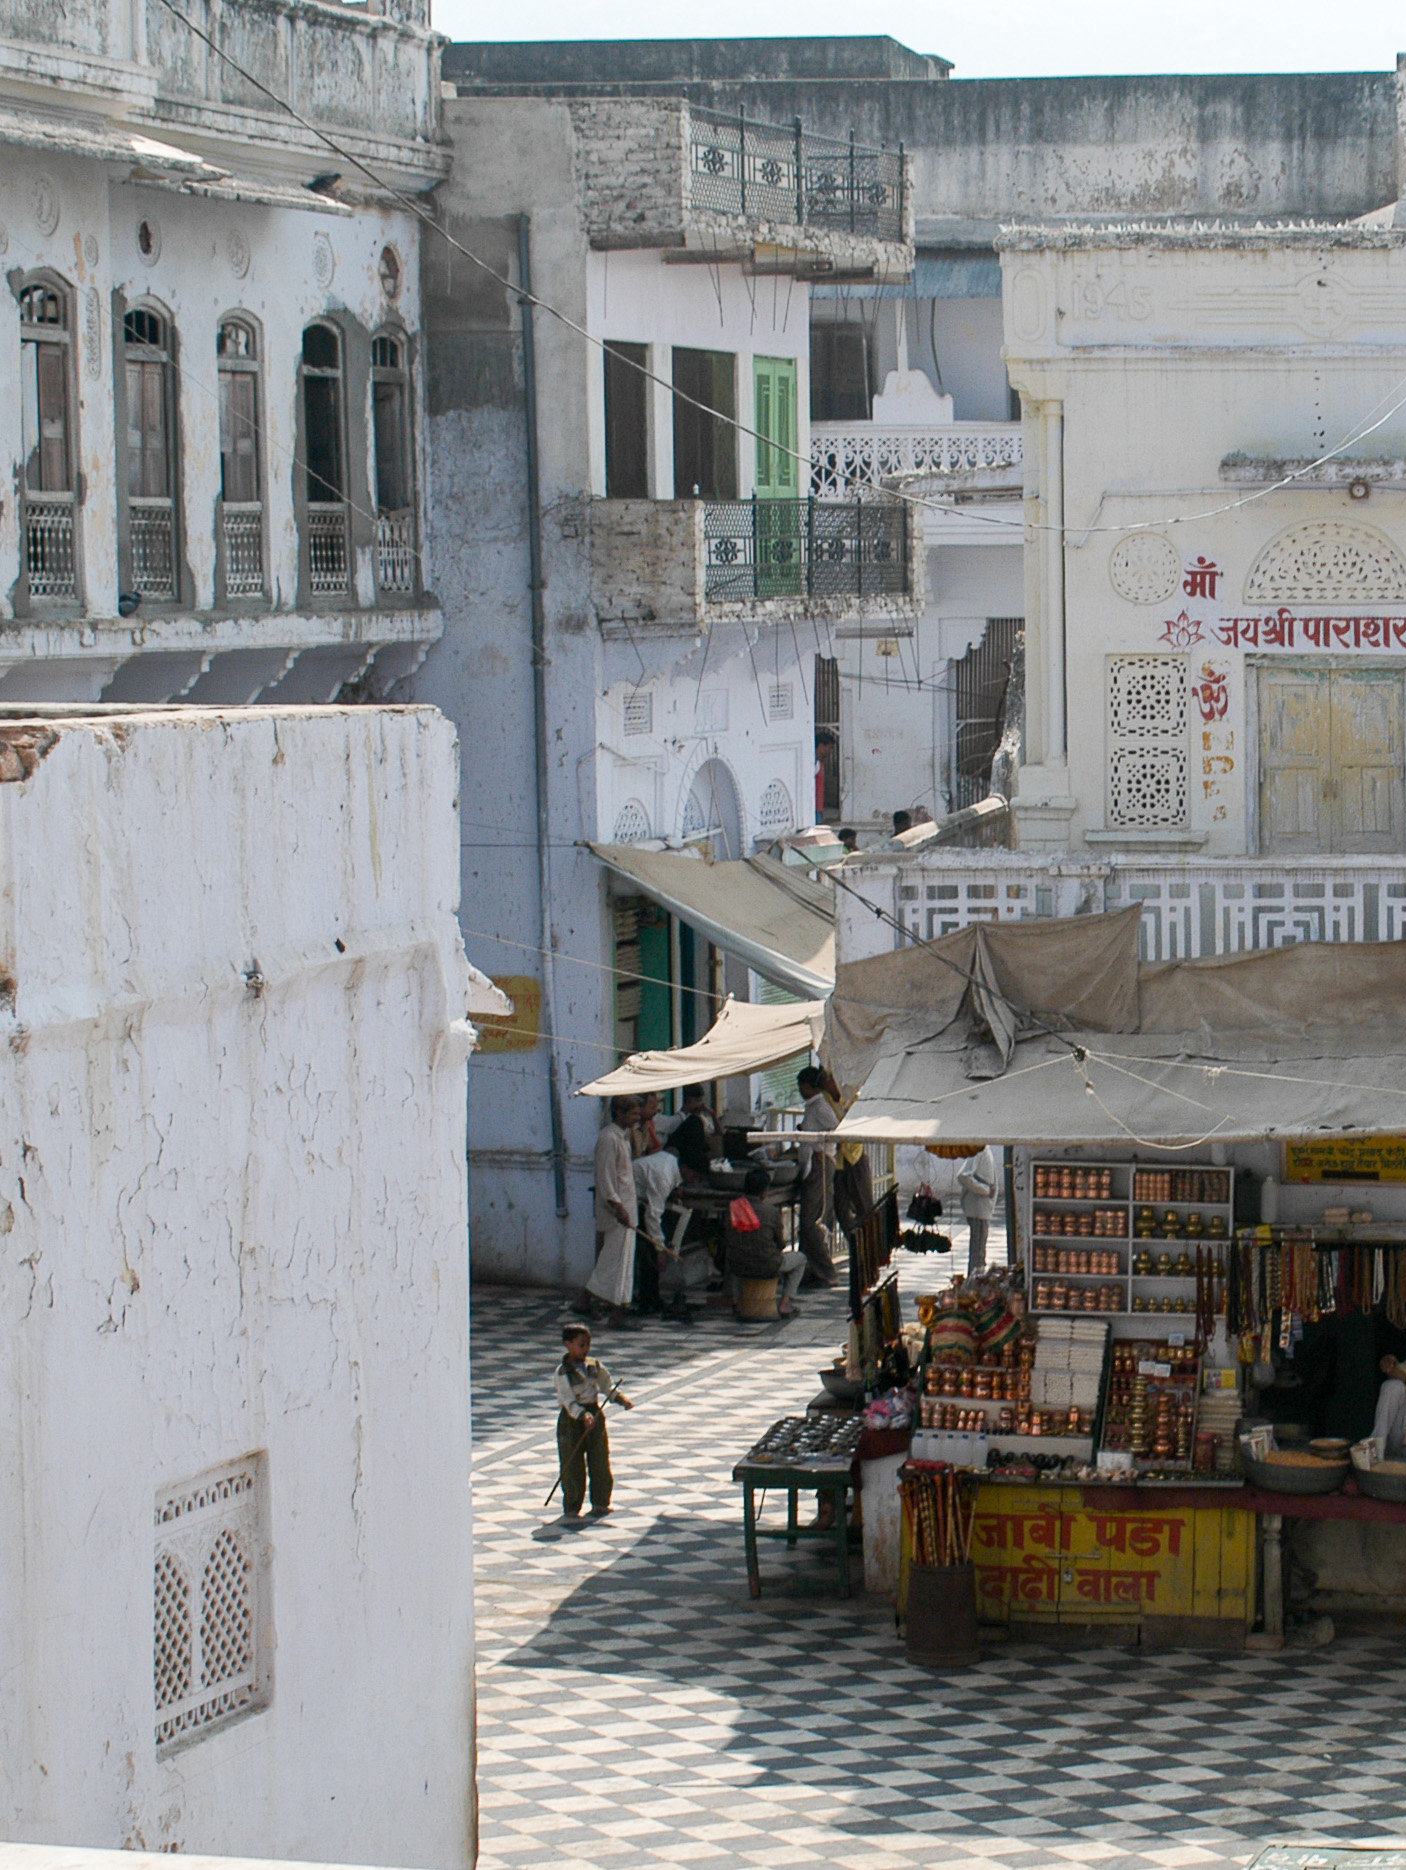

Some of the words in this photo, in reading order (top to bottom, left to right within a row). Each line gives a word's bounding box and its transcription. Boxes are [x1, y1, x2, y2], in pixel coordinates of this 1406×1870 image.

[1072, 280, 1153, 321] 1945
[1183, 555, 1220, 600] माँ
[1075, 1568, 1162, 1603] वाला
